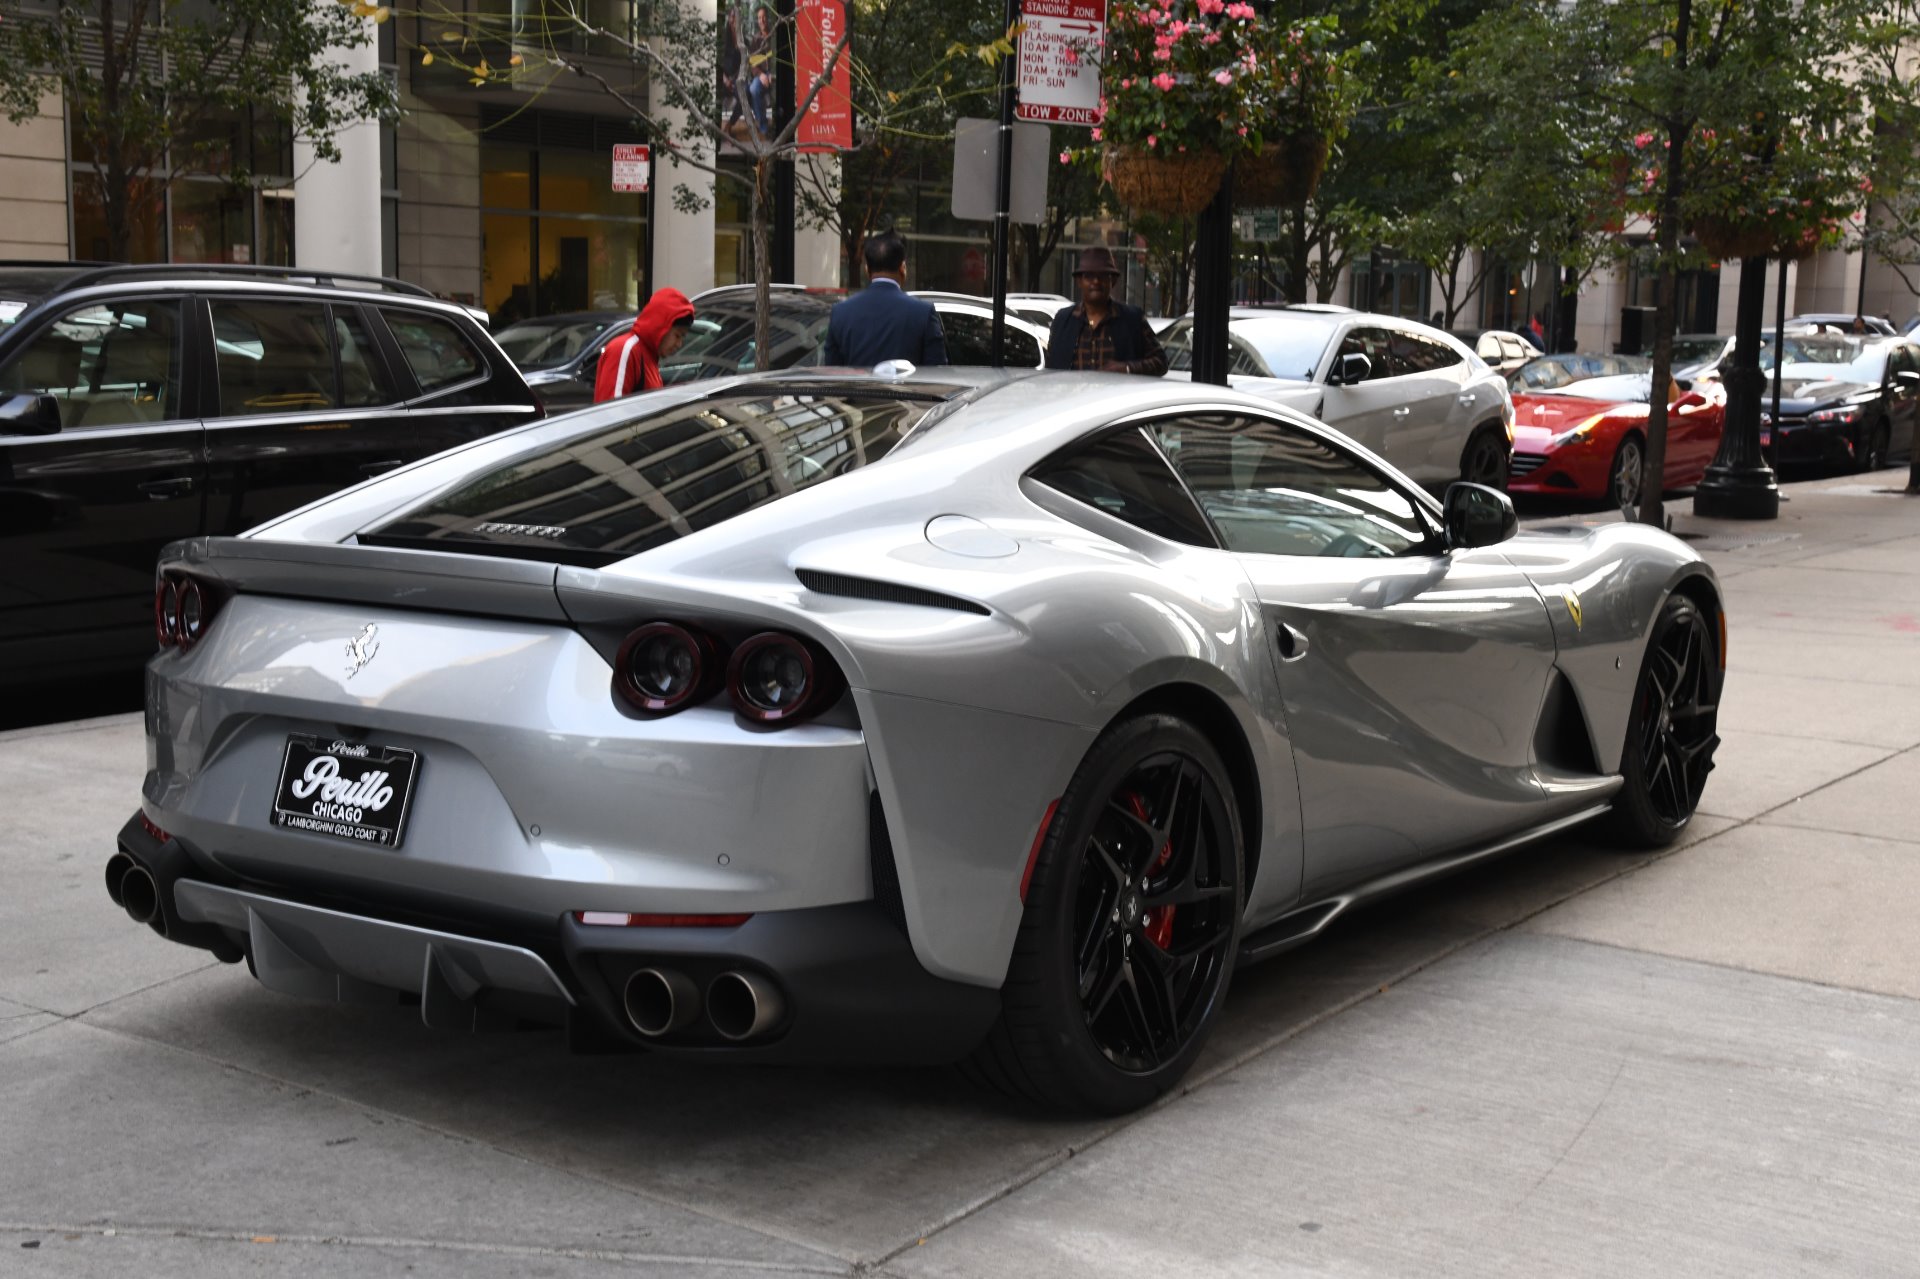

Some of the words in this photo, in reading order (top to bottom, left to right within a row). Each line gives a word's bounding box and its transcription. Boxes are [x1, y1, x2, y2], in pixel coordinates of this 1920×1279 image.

[1026, 2, 1069, 15] STANDING
[1073, 7, 1096, 19] ZONE
[1025, 19, 1042, 30] USE
[1024, 31, 1067, 44] FLASHING
[1023, 54, 1044, 63] MON
[1065, 68, 1078, 78] PM
[1023, 76, 1038, 86] FRI
[1046, 78, 1065, 88] SUN
[1023, 104, 1051, 119] TOW
[1058, 108, 1093, 122] ZONE
[615, 153, 645, 161] CLEANING
[292, 755, 394, 812] Perillo
[312, 800, 363, 824] CHICAGO
[287, 816, 335, 834] LAMBORGHINI
[334, 824, 354, 837] GOLD
[354, 827, 378, 841] COAST
